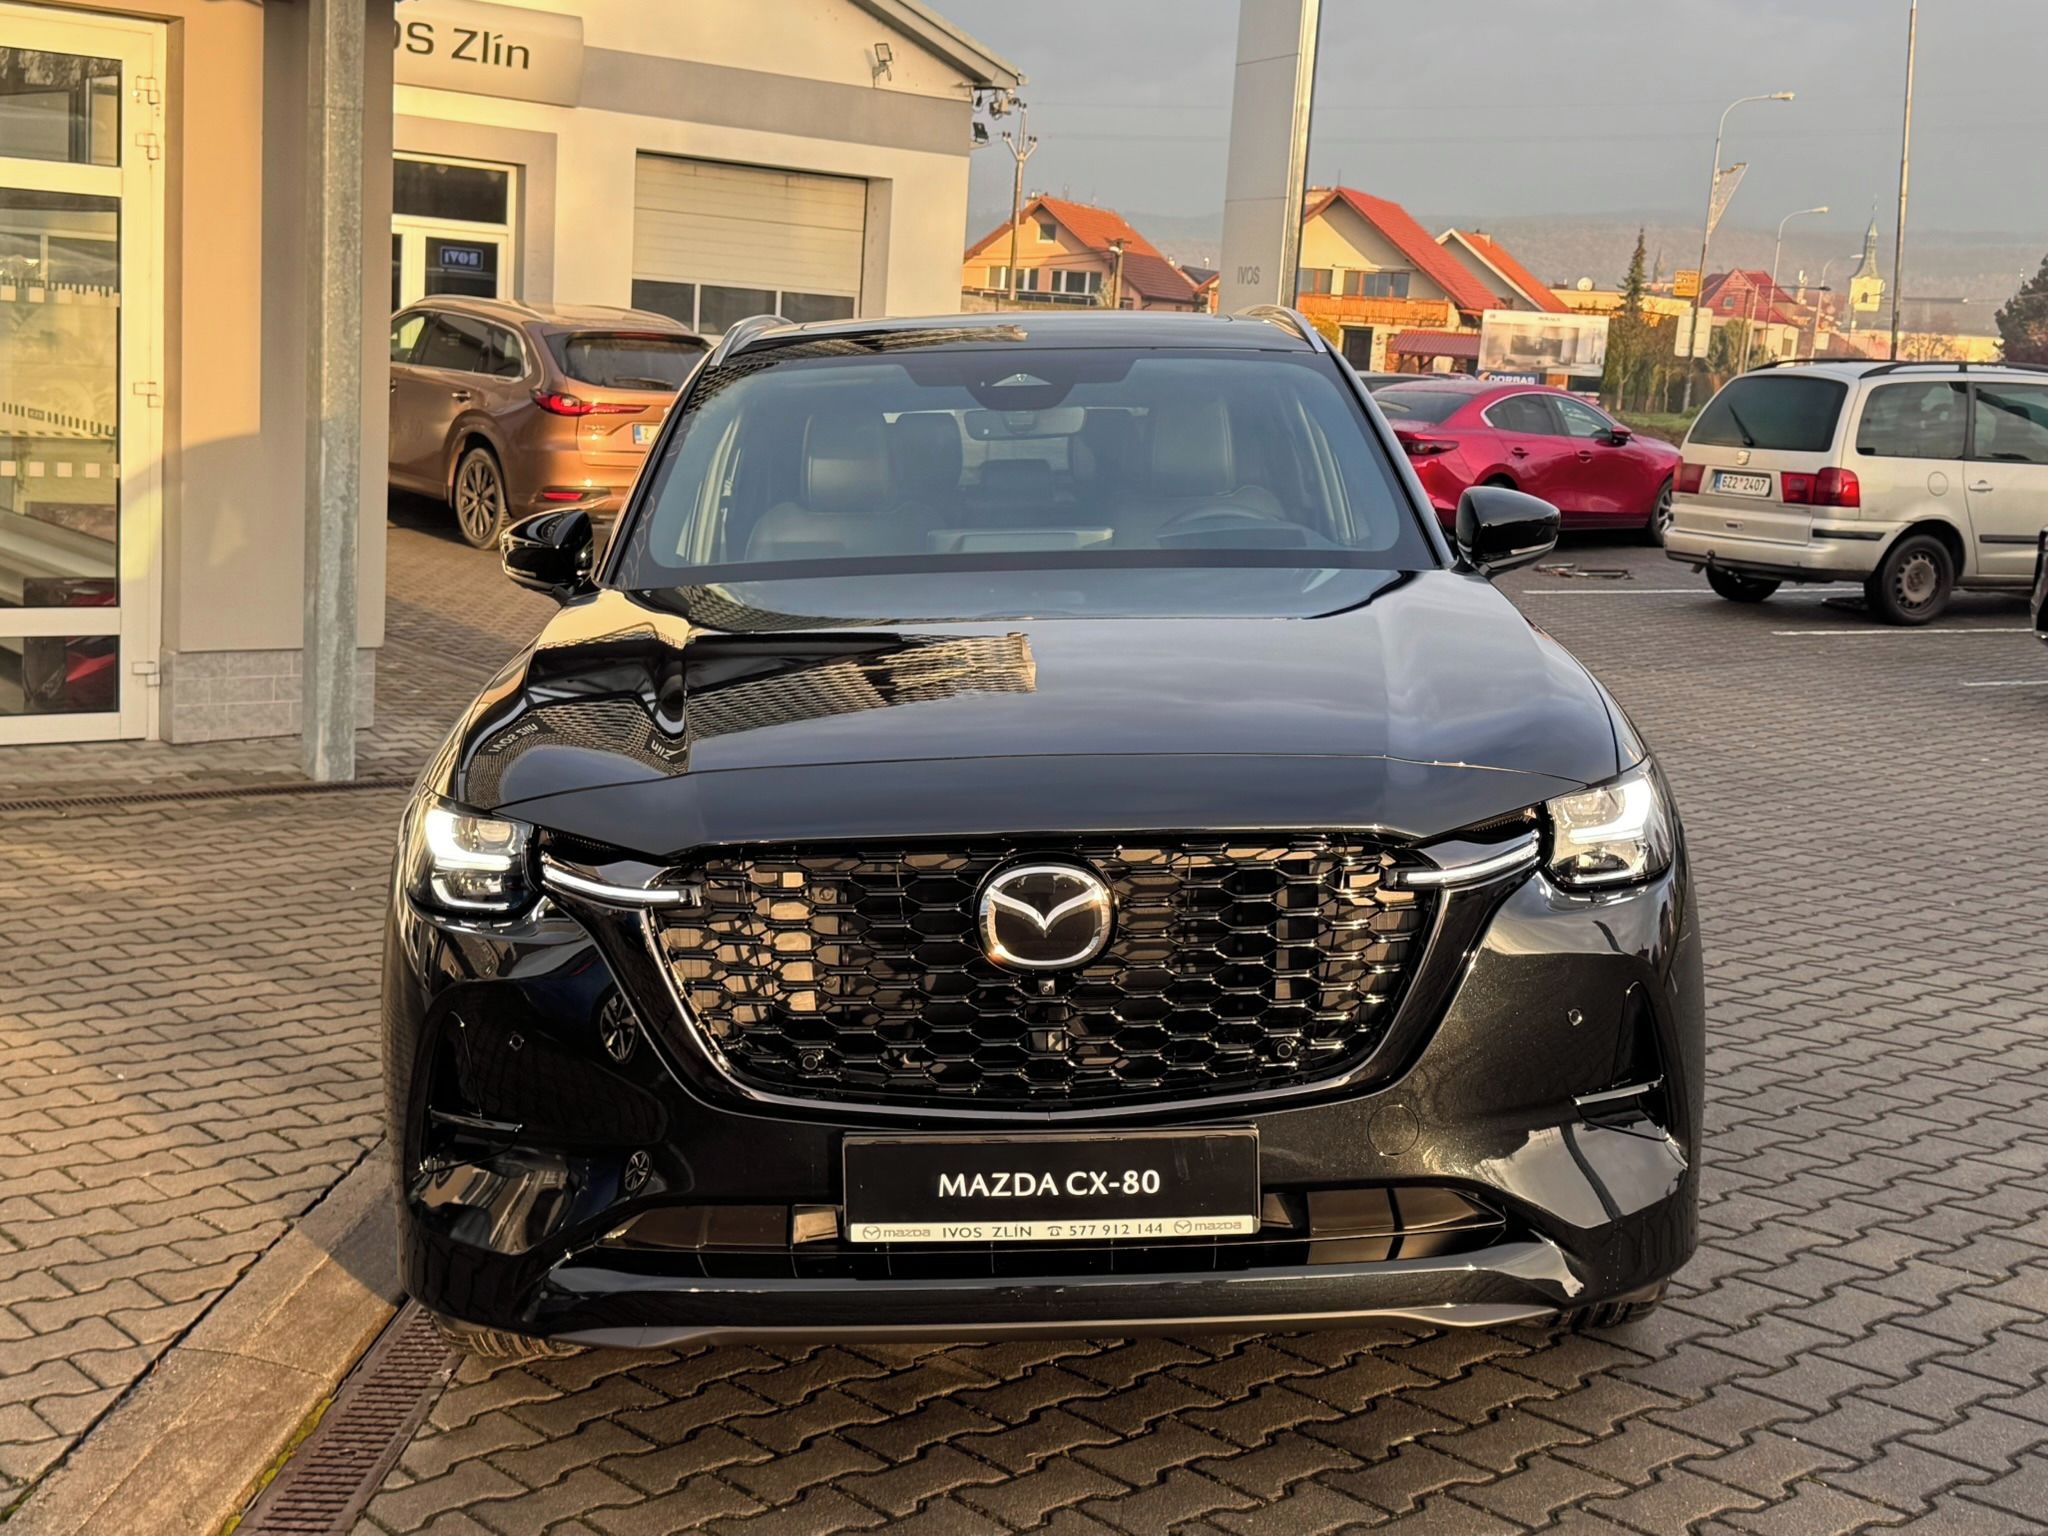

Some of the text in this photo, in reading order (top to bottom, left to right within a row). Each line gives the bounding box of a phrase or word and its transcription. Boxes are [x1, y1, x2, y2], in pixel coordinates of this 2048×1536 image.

[394, 20, 530, 69] S Zlín
[1237, 265, 1260, 285] IVOS
[938, 1170, 1161, 1198] MAZDA CX-80
[883, 1220, 1242, 1239] mazda IVOS ZLÍN 577 912 144 mazda
